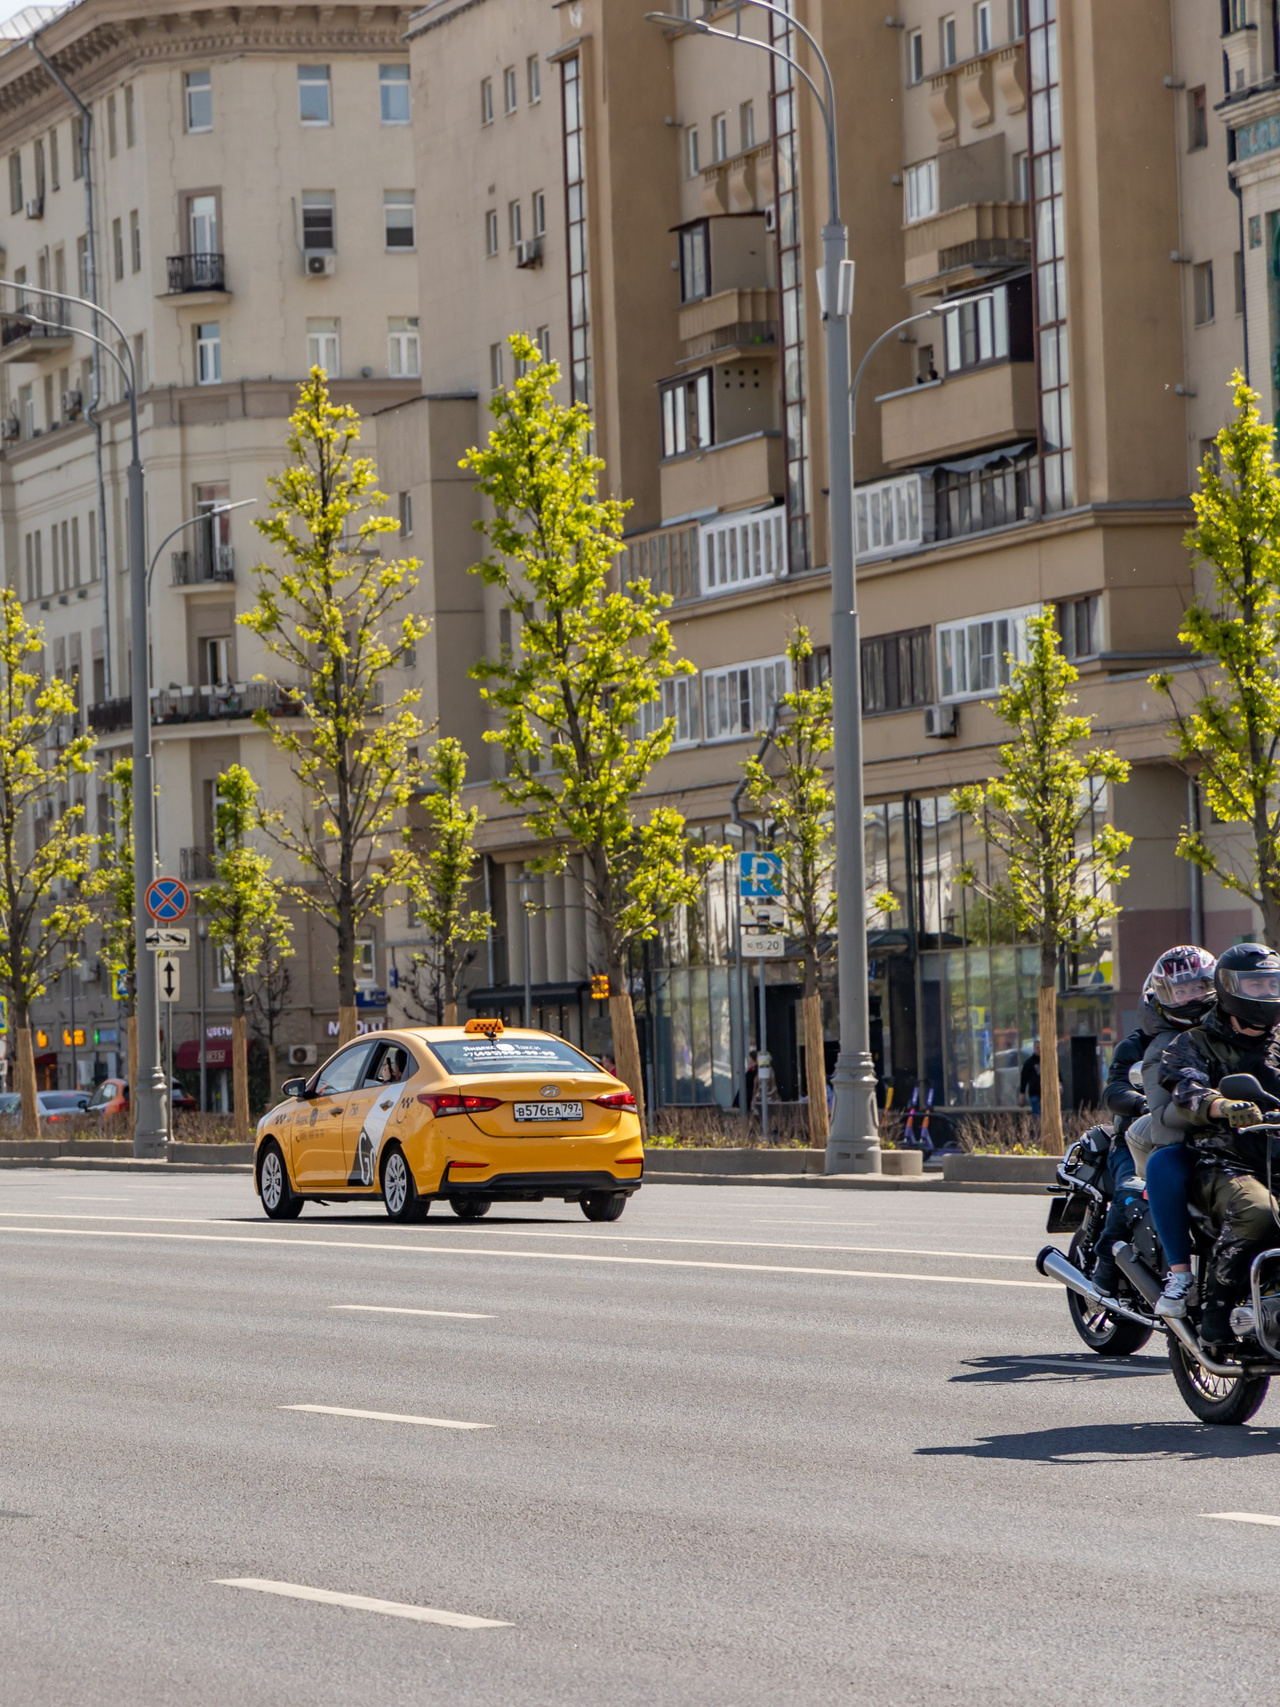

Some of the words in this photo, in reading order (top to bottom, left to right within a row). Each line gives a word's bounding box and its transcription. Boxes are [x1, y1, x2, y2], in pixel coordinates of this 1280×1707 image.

[755, 941, 764, 949] 15
[766, 940, 780, 950] 20
[518, 1104, 561, 1117] В576ЕА
[562, 1103, 579, 1112] 797
